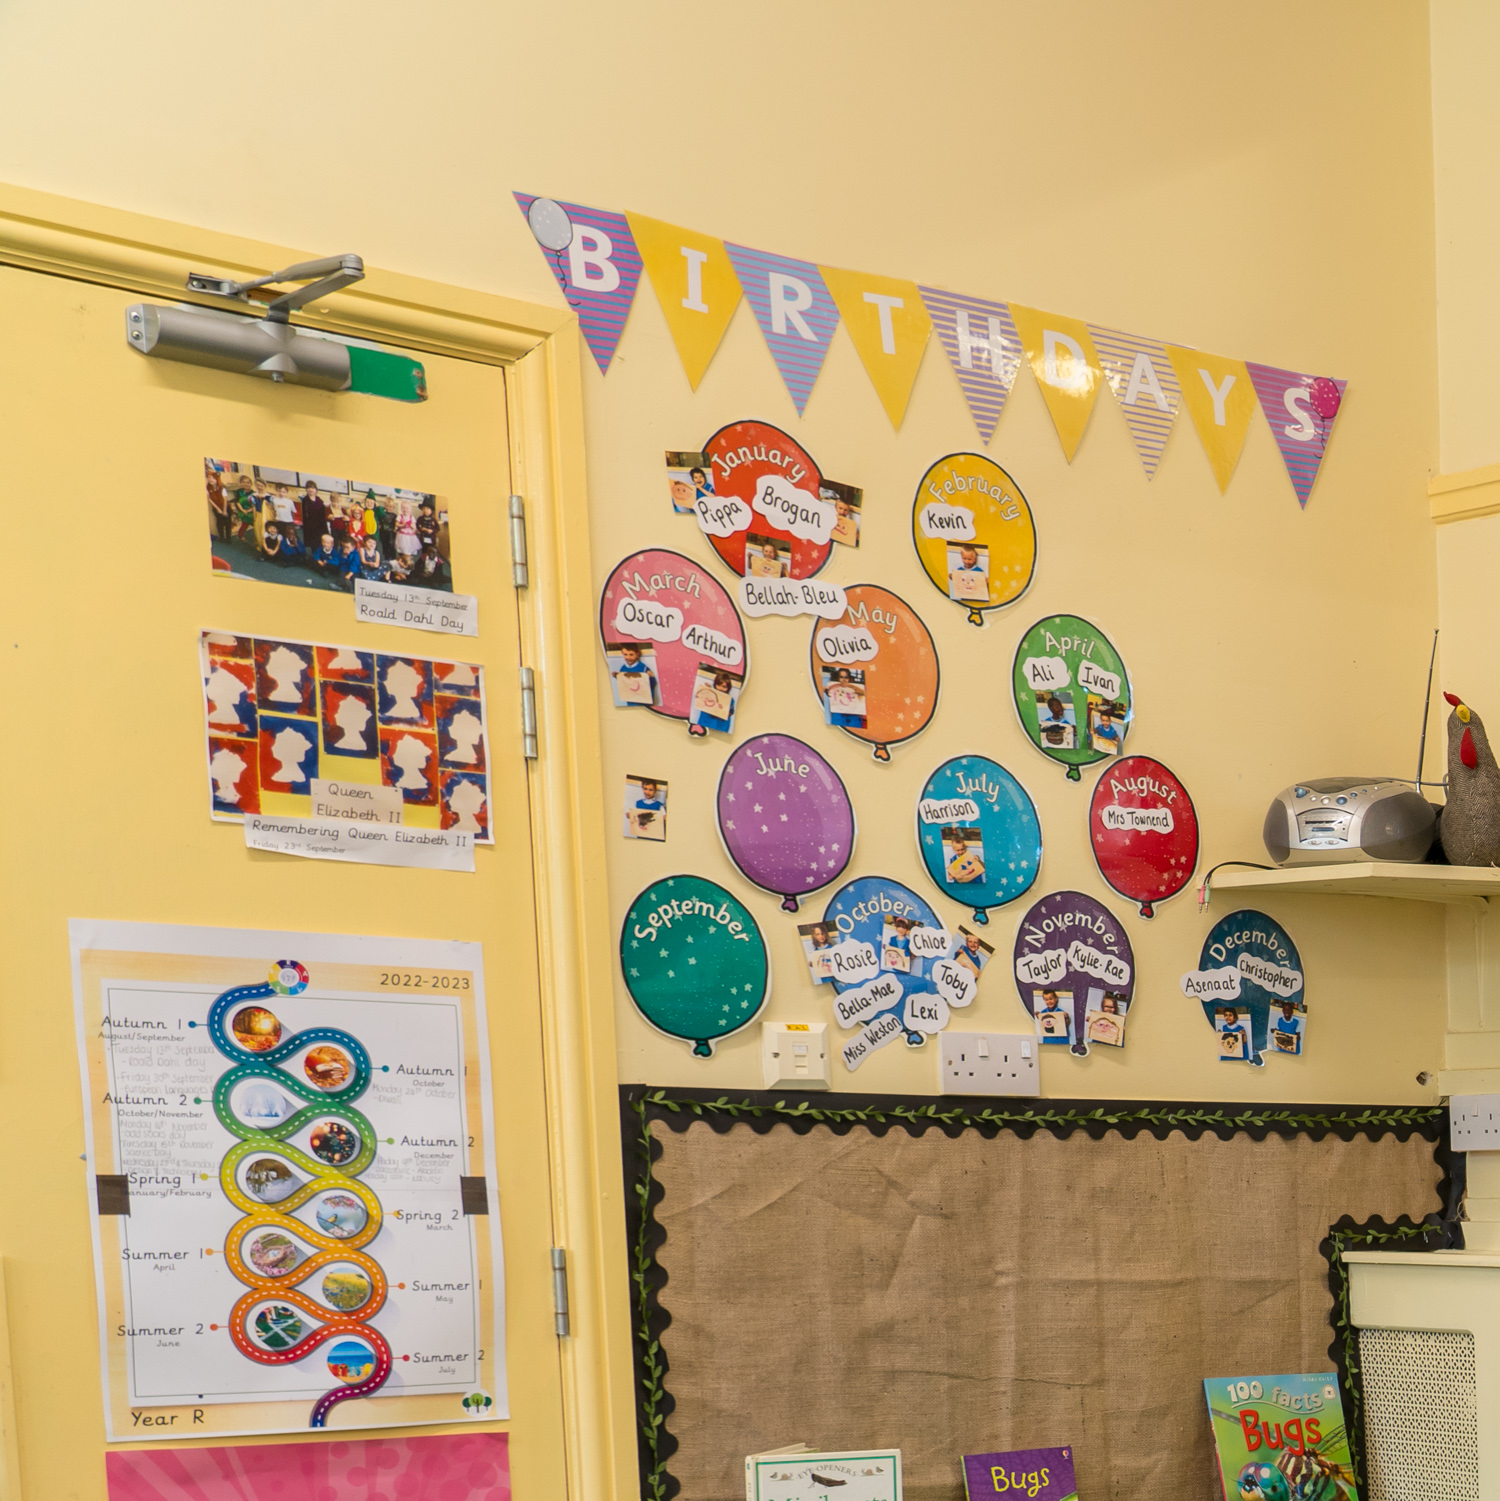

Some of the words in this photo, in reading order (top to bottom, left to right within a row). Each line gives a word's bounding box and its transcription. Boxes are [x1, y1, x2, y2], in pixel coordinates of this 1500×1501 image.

[568, 223, 1316, 442] BIRTHDAYS
[711, 445, 806, 484] January
[763, 487, 822, 529] Brogan
[929, 470, 1021, 521] February
[698, 501, 742, 529] Pippa
[928, 510, 967, 530] Kevin
[621, 572, 701, 600] March
[360, 587, 398, 603] Tuesday
[426, 597, 468, 611] September
[361, 604, 396, 620] Roald
[404, 610, 434, 625] Dahl
[441, 616, 464, 632] Day
[623, 603, 674, 628] Oscar
[847, 601, 897, 634] May
[686, 627, 736, 659] Arthur
[823, 635, 872, 657] Olivia
[1046, 632, 1096, 658] April
[1032, 664, 1054, 682] Ali
[1082, 666, 1115, 693] Ivan
[754, 751, 810, 778] June
[329, 784, 373, 800] Queen
[955, 771, 999, 803] July
[1110, 775, 1177, 806] August
[317, 804, 380, 822] Elizabeth
[924, 802, 975, 820] Harrison
[1109, 811, 1125, 826] Mrs
[1127, 812, 1170, 829] Townend
[253, 820, 339, 841] Remembering
[348, 828, 388, 842] Queen
[395, 831, 449, 846] Elizabeth
[634, 899, 749, 942] September
[836, 892, 913, 934] October
[913, 934, 946, 950] Chloe
[1025, 910, 1119, 955] November
[834, 949, 878, 973] Rosie
[1210, 930, 1290, 968] December
[1022, 954, 1063, 979] Taylor
[1239, 960, 1298, 990] Christopher
[380, 974, 471, 990] 2022-2023
[940, 964, 968, 999] Toby
[838, 982, 895, 1020] Bella-Mae
[911, 1000, 938, 1020] Lexi
[101, 1016, 167, 1029] Autumn
[845, 1042, 867, 1063] Miss
[865, 1018, 900, 1046] Weston
[396, 1064, 454, 1076] Autumn
[102, 1092, 168, 1105] Autumn
[179, 1094, 187, 1106] 2
[400, 1135, 458, 1147] Autumn
[467, 1136, 475, 1147] 2
[129, 1172, 181, 1188] Spring
[396, 1209, 441, 1224] Spring
[451, 1209, 459, 1221] 2
[122, 1247, 189, 1261] Summer
[412, 1280, 470, 1292] Summer
[117, 1323, 185, 1337] Summer
[195, 1323, 204, 1335] 2
[413, 1351, 469, 1364] Summer
[477, 1350, 485, 1361] 2
[1227, 1381, 1264, 1402] 100
[1272, 1386, 1323, 1410] facts
[131, 1410, 178, 1428] Year
[193, 1409, 205, 1424] R
[1239, 1409, 1322, 1456] Bugs
[797, 1466, 814, 1480] EYE
[816, 1464, 858, 1477] OPENERS
[990, 1466, 1051, 1497] Bugs
